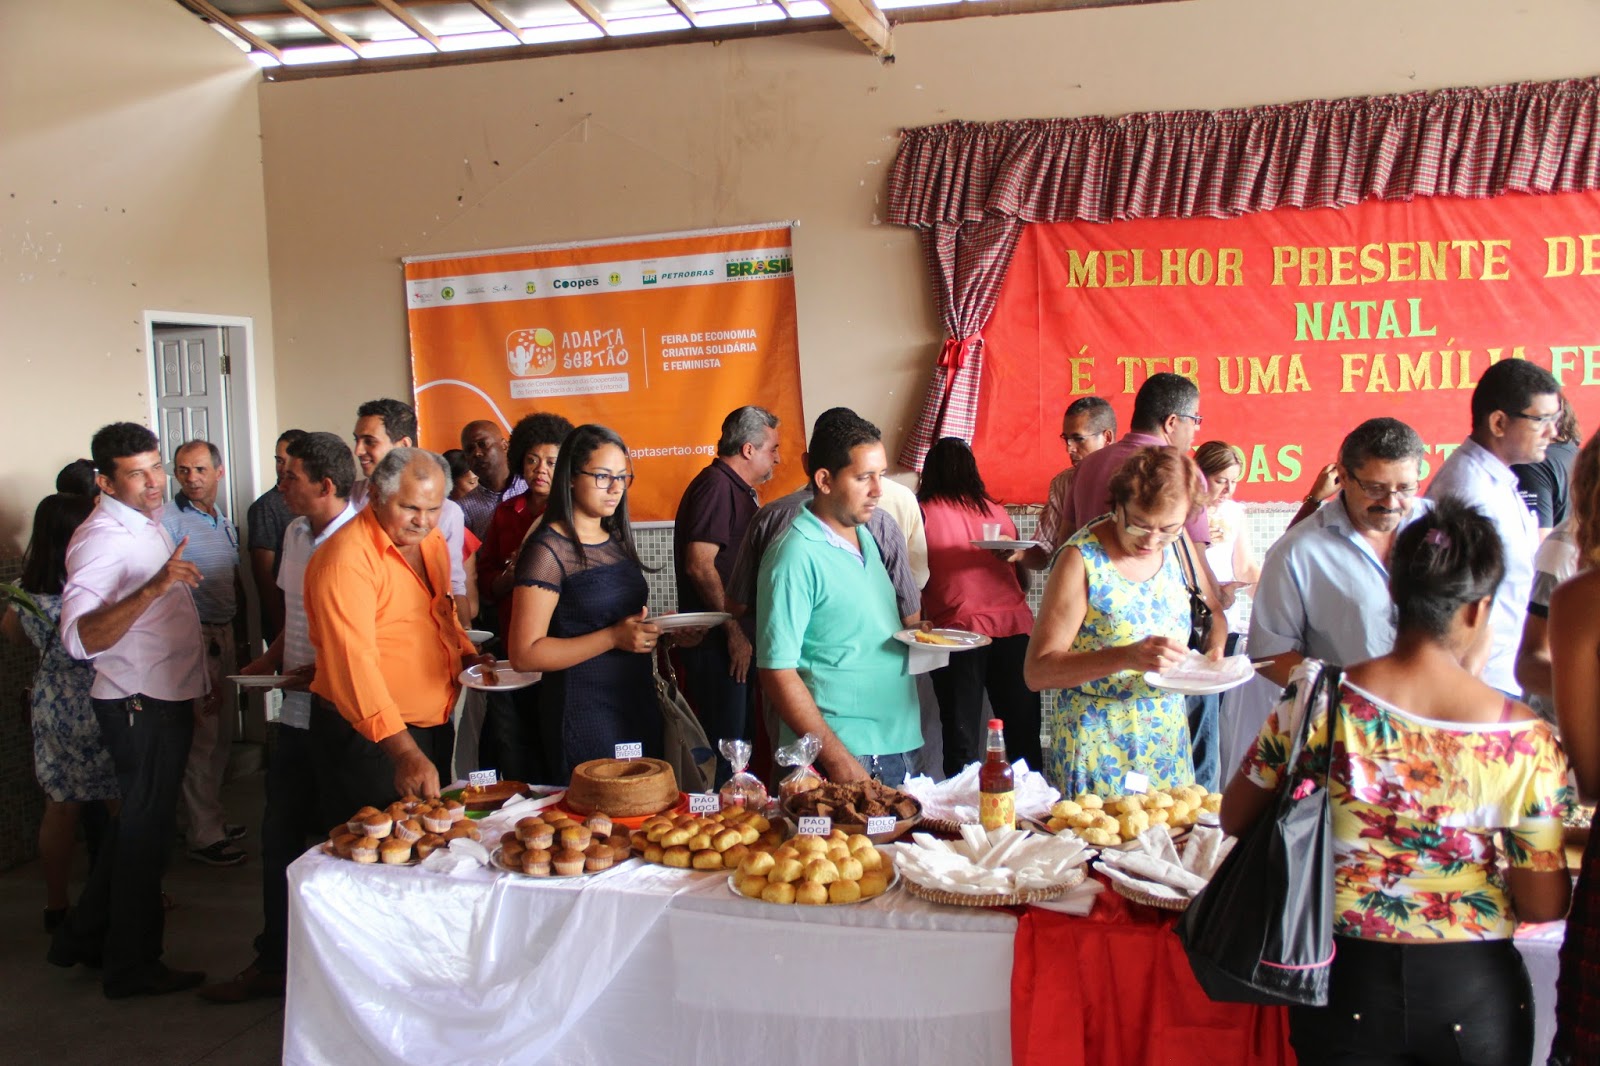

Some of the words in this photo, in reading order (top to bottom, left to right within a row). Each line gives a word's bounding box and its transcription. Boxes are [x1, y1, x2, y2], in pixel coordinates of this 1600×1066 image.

[1065, 248, 1243, 288] MELHOR
[1272, 239, 1511, 286] PRESENTE
[1543, 234, 1600, 278] DE
[661, 269, 715, 280] PETROBRAS
[726, 258, 793, 278] BRASIL
[553, 278, 599, 289] Coopes
[1294, 298, 1437, 341] NATAL
[562, 328, 624, 349] ADAPTA
[661, 334, 689, 345] FEIRA
[690, 333, 703, 343] DE
[705, 329, 757, 342] ECONOMIA
[662, 346, 705, 358] CRIATIVA
[706, 341, 757, 355] SOLIDÁRIA
[663, 361, 670, 371] E
[671, 358, 721, 370] FEMINISTA
[1069, 346, 1096, 395] É
[1217, 353, 1312, 395] UMA
[1342, 337, 1525, 394] FAMÍL
[615, 743, 641, 751] BOLO
[470, 771, 496, 780] BOLO
[691, 804, 718, 812] DOCE
[868, 818, 895, 826] BOLO
[799, 826, 829, 834] DOCE
